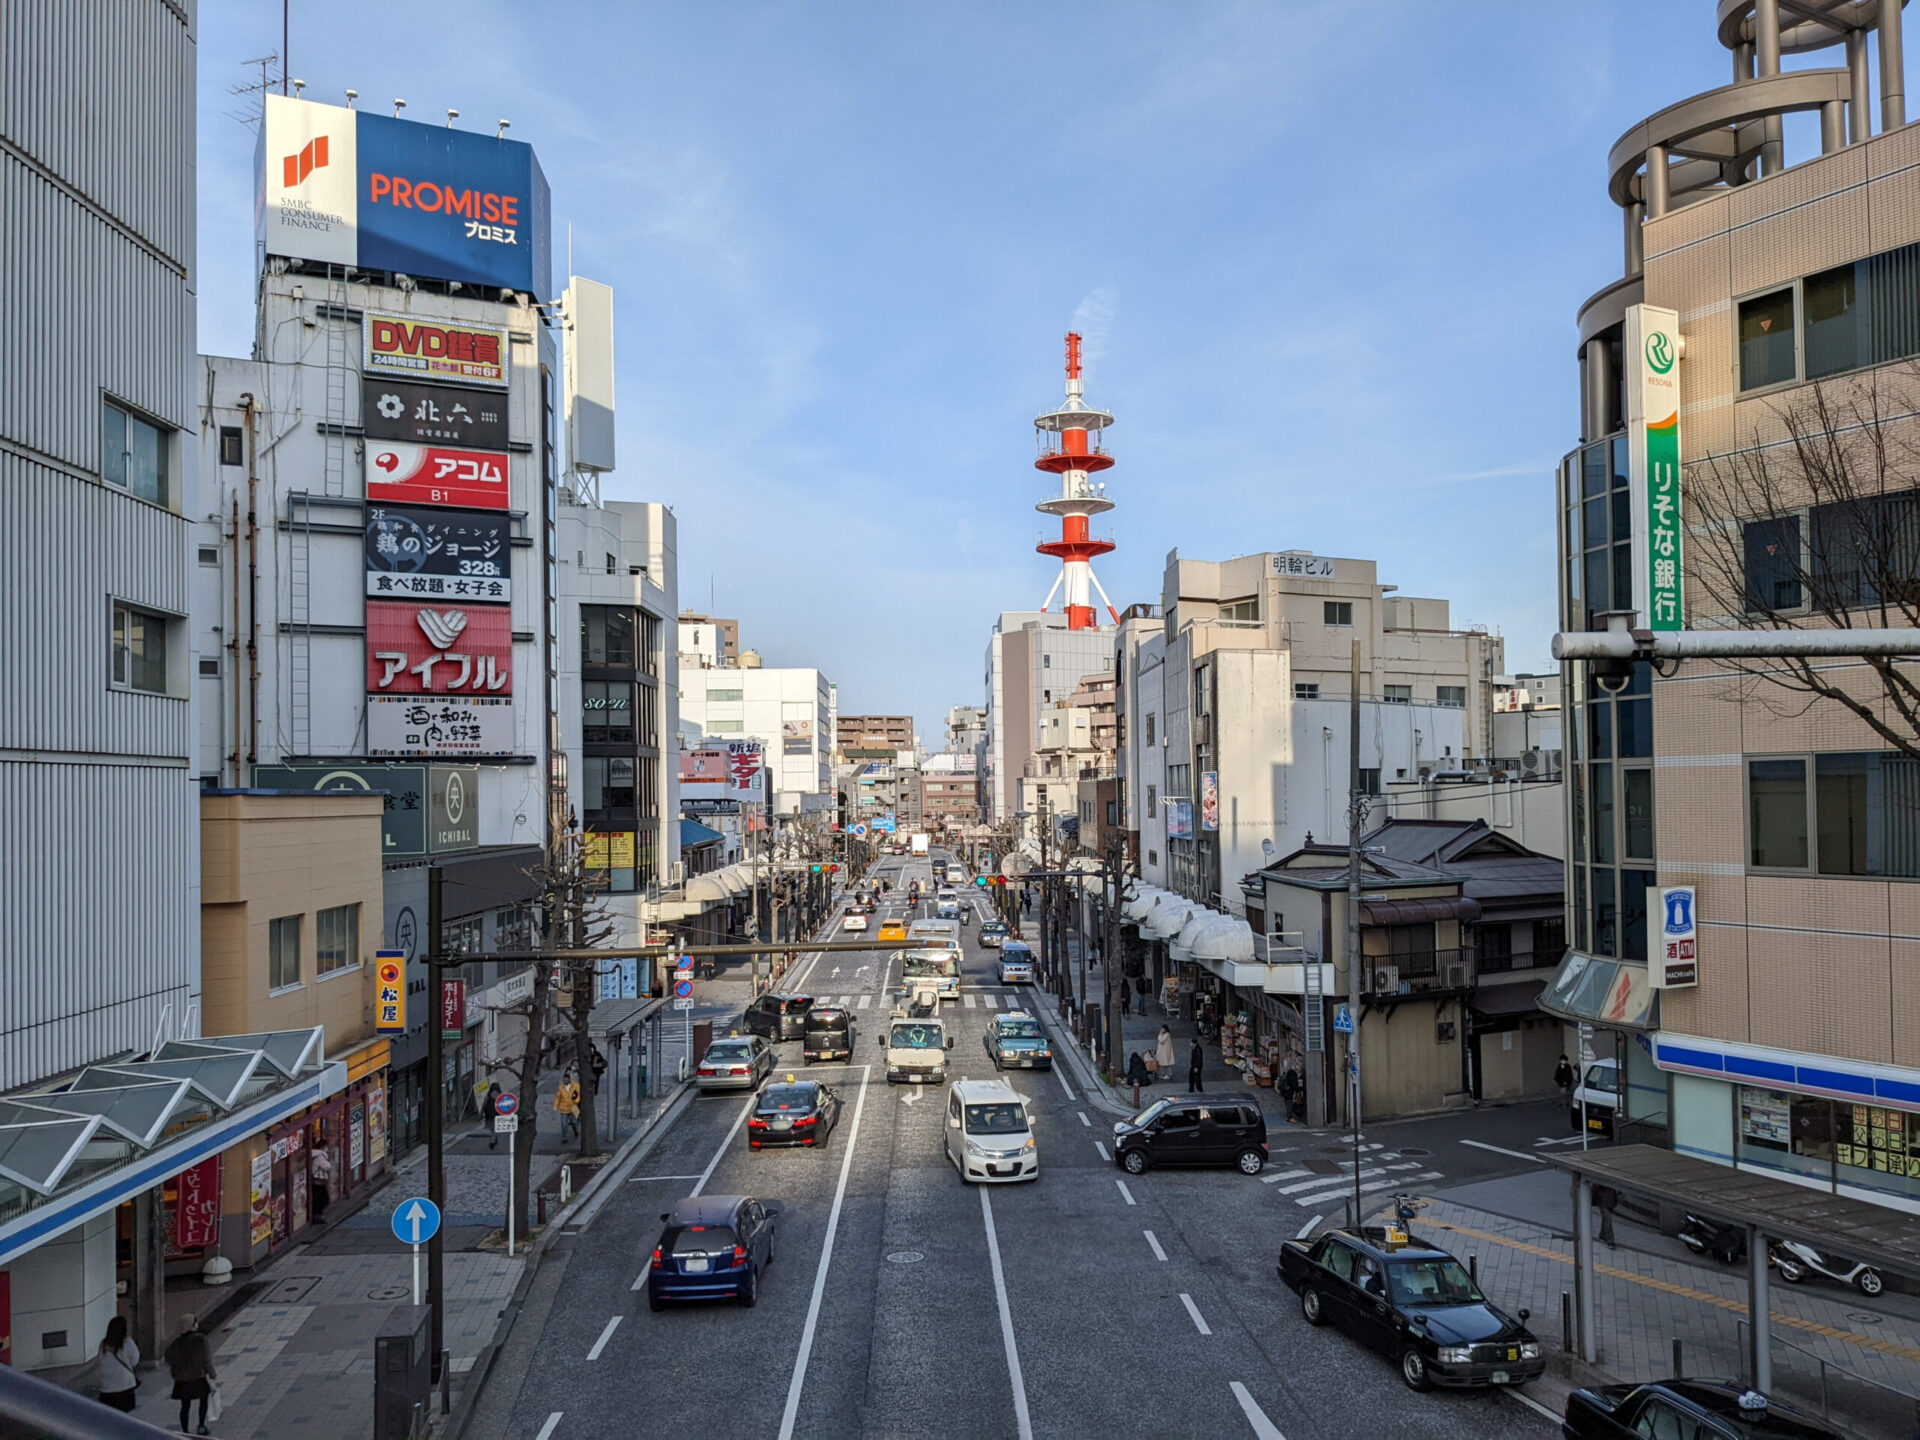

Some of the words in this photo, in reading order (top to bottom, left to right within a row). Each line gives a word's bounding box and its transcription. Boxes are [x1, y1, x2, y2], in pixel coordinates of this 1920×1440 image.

[281, 197, 312, 211] SMBC
[371, 173, 518, 225] PROMISE
[280, 207, 344, 225] CONSUMER
[281, 216, 331, 232] FINANCE
[464, 221, 518, 245] プロミス
[372, 319, 500, 366] DVD鑑賞
[374, 353, 427, 370] 24時間営業
[1648, 376, 1673, 388] RESONA
[415, 399, 473, 424] 北六
[434, 457, 502, 483] アコム
[431, 490, 449, 502] B1
[371, 509, 386, 520] 2F
[376, 533, 501, 559] 鶏のジョージ
[1653, 461, 1675, 622] りそな銀行
[1273, 556, 1333, 576] 明輪ビル
[376, 575, 503, 597] 食べ放題・女子会
[375, 651, 507, 691] アイフル
[405, 706, 478, 726] 酒と和みと
[729, 743, 761, 753] 新堀
[731, 753, 761, 790] ギター
[438, 829, 471, 844] ICHIBAL
[1667, 922, 1691, 933] STATION
[1667, 942, 1678, 959] 酒
[1680, 942, 1694, 957] ATM
[381, 986, 398, 1022] 松屋
[444, 982, 454, 1029] ホームメイト
[1854, 1105, 1902, 1130] 母の日
[1854, 1126, 1902, 1150] 父の日
[1837, 1145, 1920, 1177] ギフト承り
